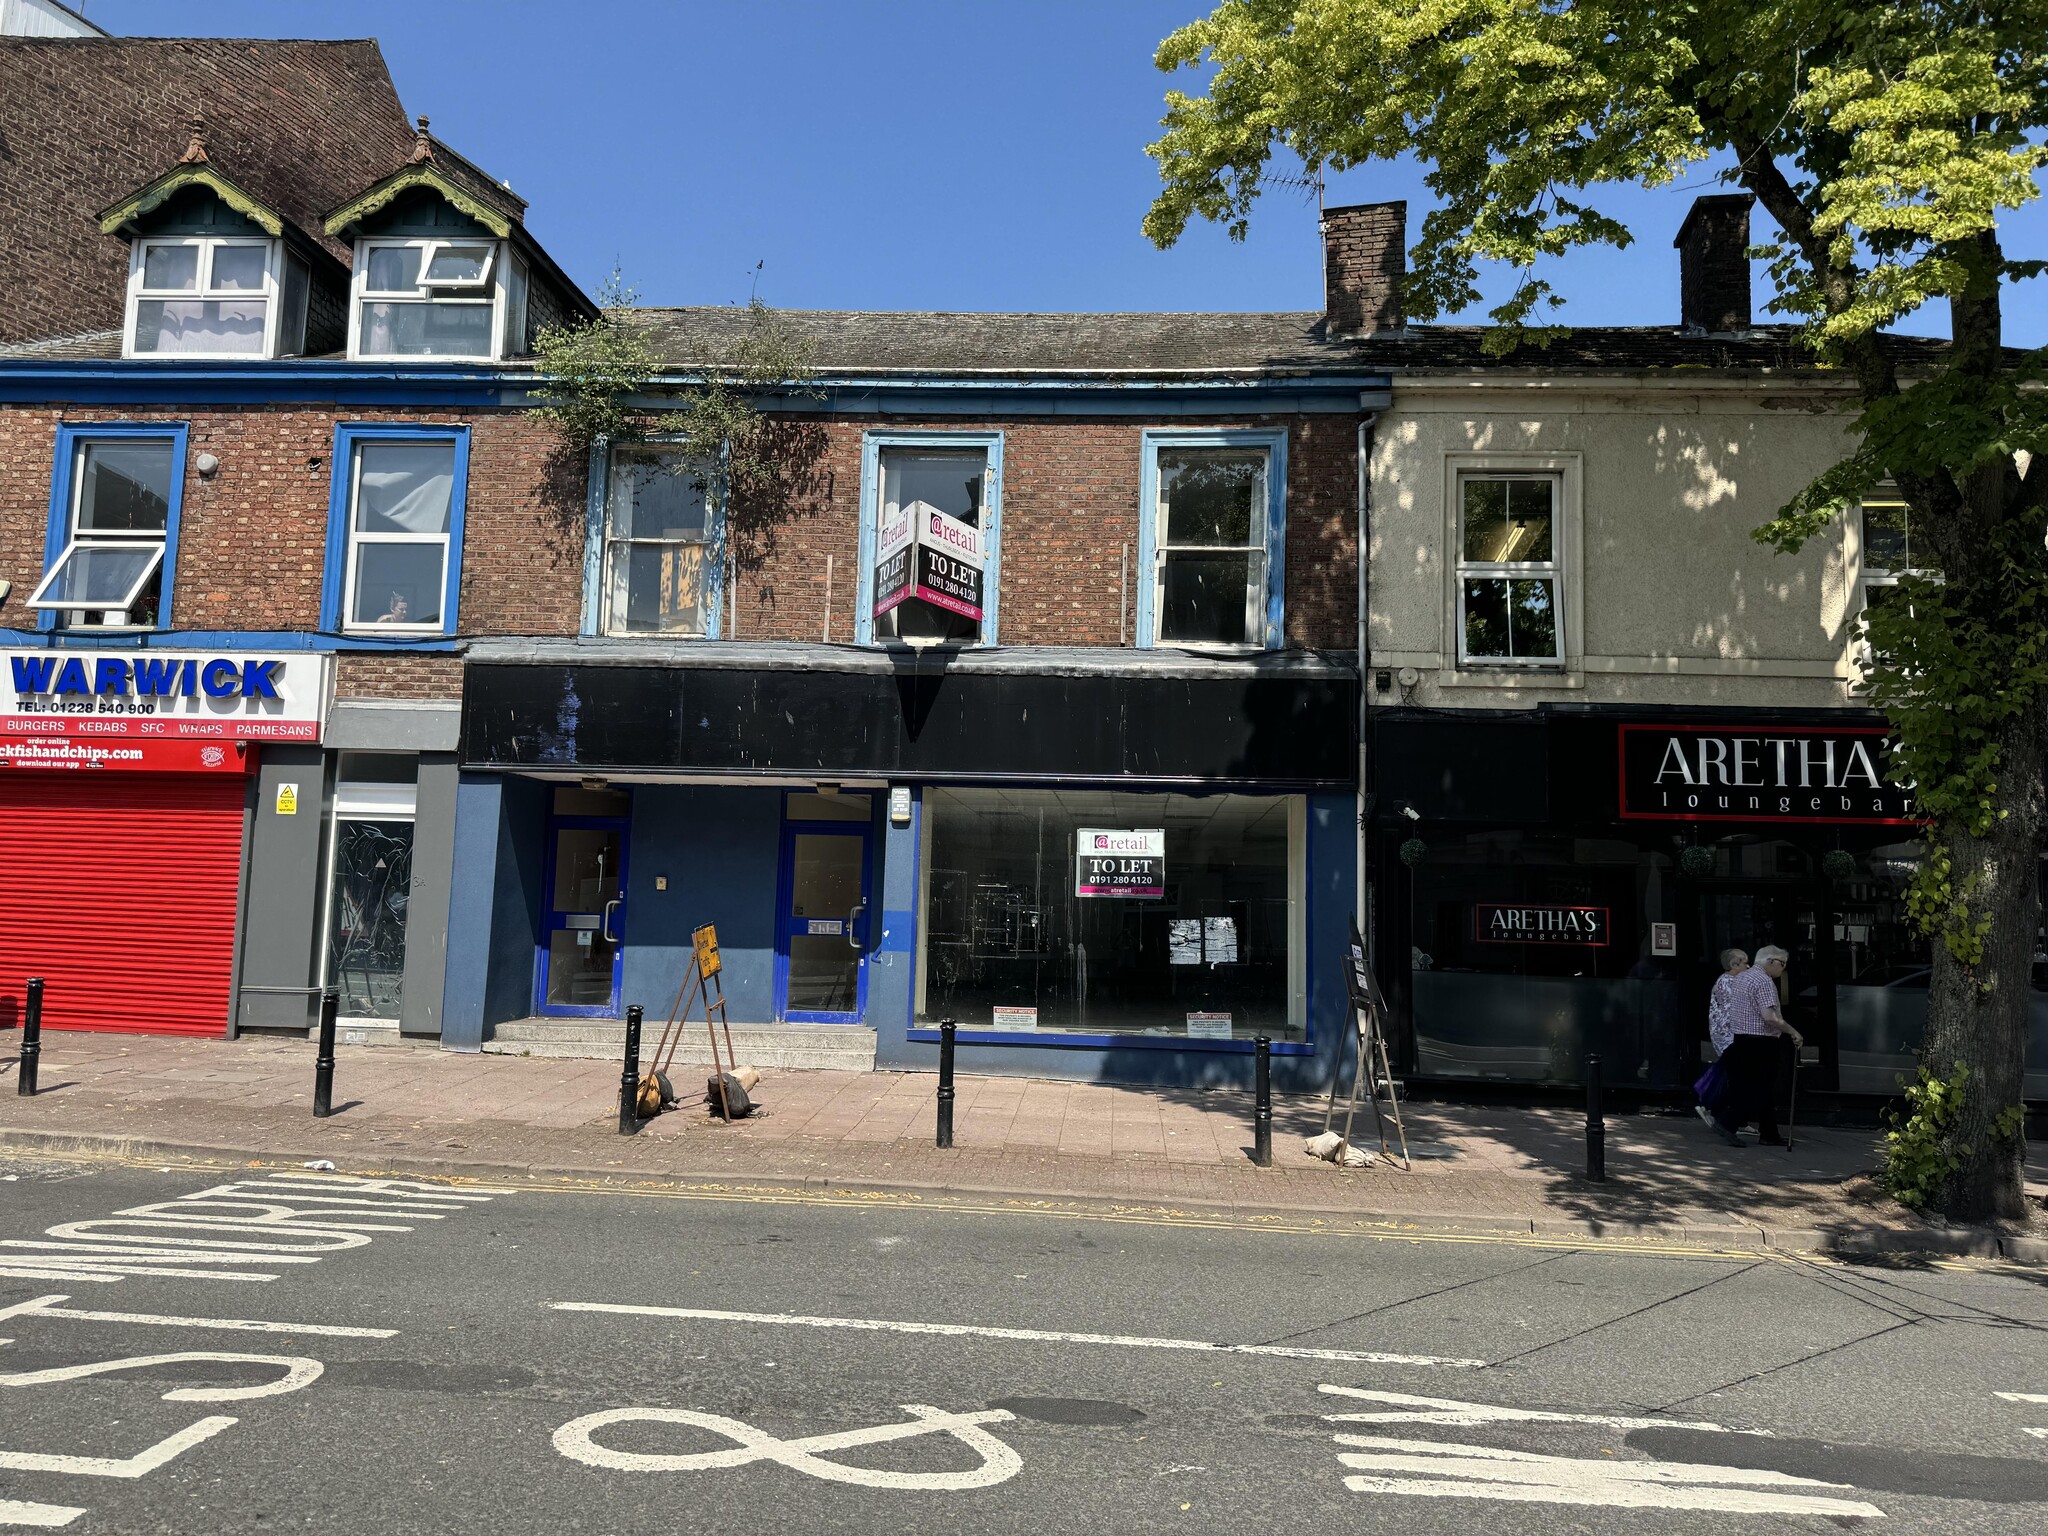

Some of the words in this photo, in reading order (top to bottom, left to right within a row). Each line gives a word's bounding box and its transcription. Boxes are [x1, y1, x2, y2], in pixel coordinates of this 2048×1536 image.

[931, 513, 977, 554] @retail
[879, 563, 890, 583] TO
[890, 551, 906, 576] LET
[929, 552, 948, 575] TO
[950, 562, 977, 587] LET
[928, 573, 944, 589] 0191
[945, 581, 959, 595] 280
[959, 587, 977, 602] 4120
[926, 591, 976, 616] www.atretail.co.uk
[11, 657, 286, 699] WARWICK
[16, 702, 46, 713] TEL:
[50, 703, 94, 714] 01228
[99, 703, 124, 714] 540
[128, 704, 155, 715] 900
[7, 721, 65, 732] BURGERS
[79, 722, 128, 732] KEBABS
[141, 723, 165, 733] SFC
[179, 724, 223, 734] WRAPS
[236, 725, 313, 736] PARMESANS
[1095, 835, 1148, 849] @retail
[1090, 859, 1116, 873] TO
[1120, 859, 1152, 873] LET
[1090, 876, 1110, 884] 0191
[1113, 876, 1129, 884] 280
[1131, 876, 1152, 884] 4120
[1490, 909, 1596, 932] ARETHA'S
